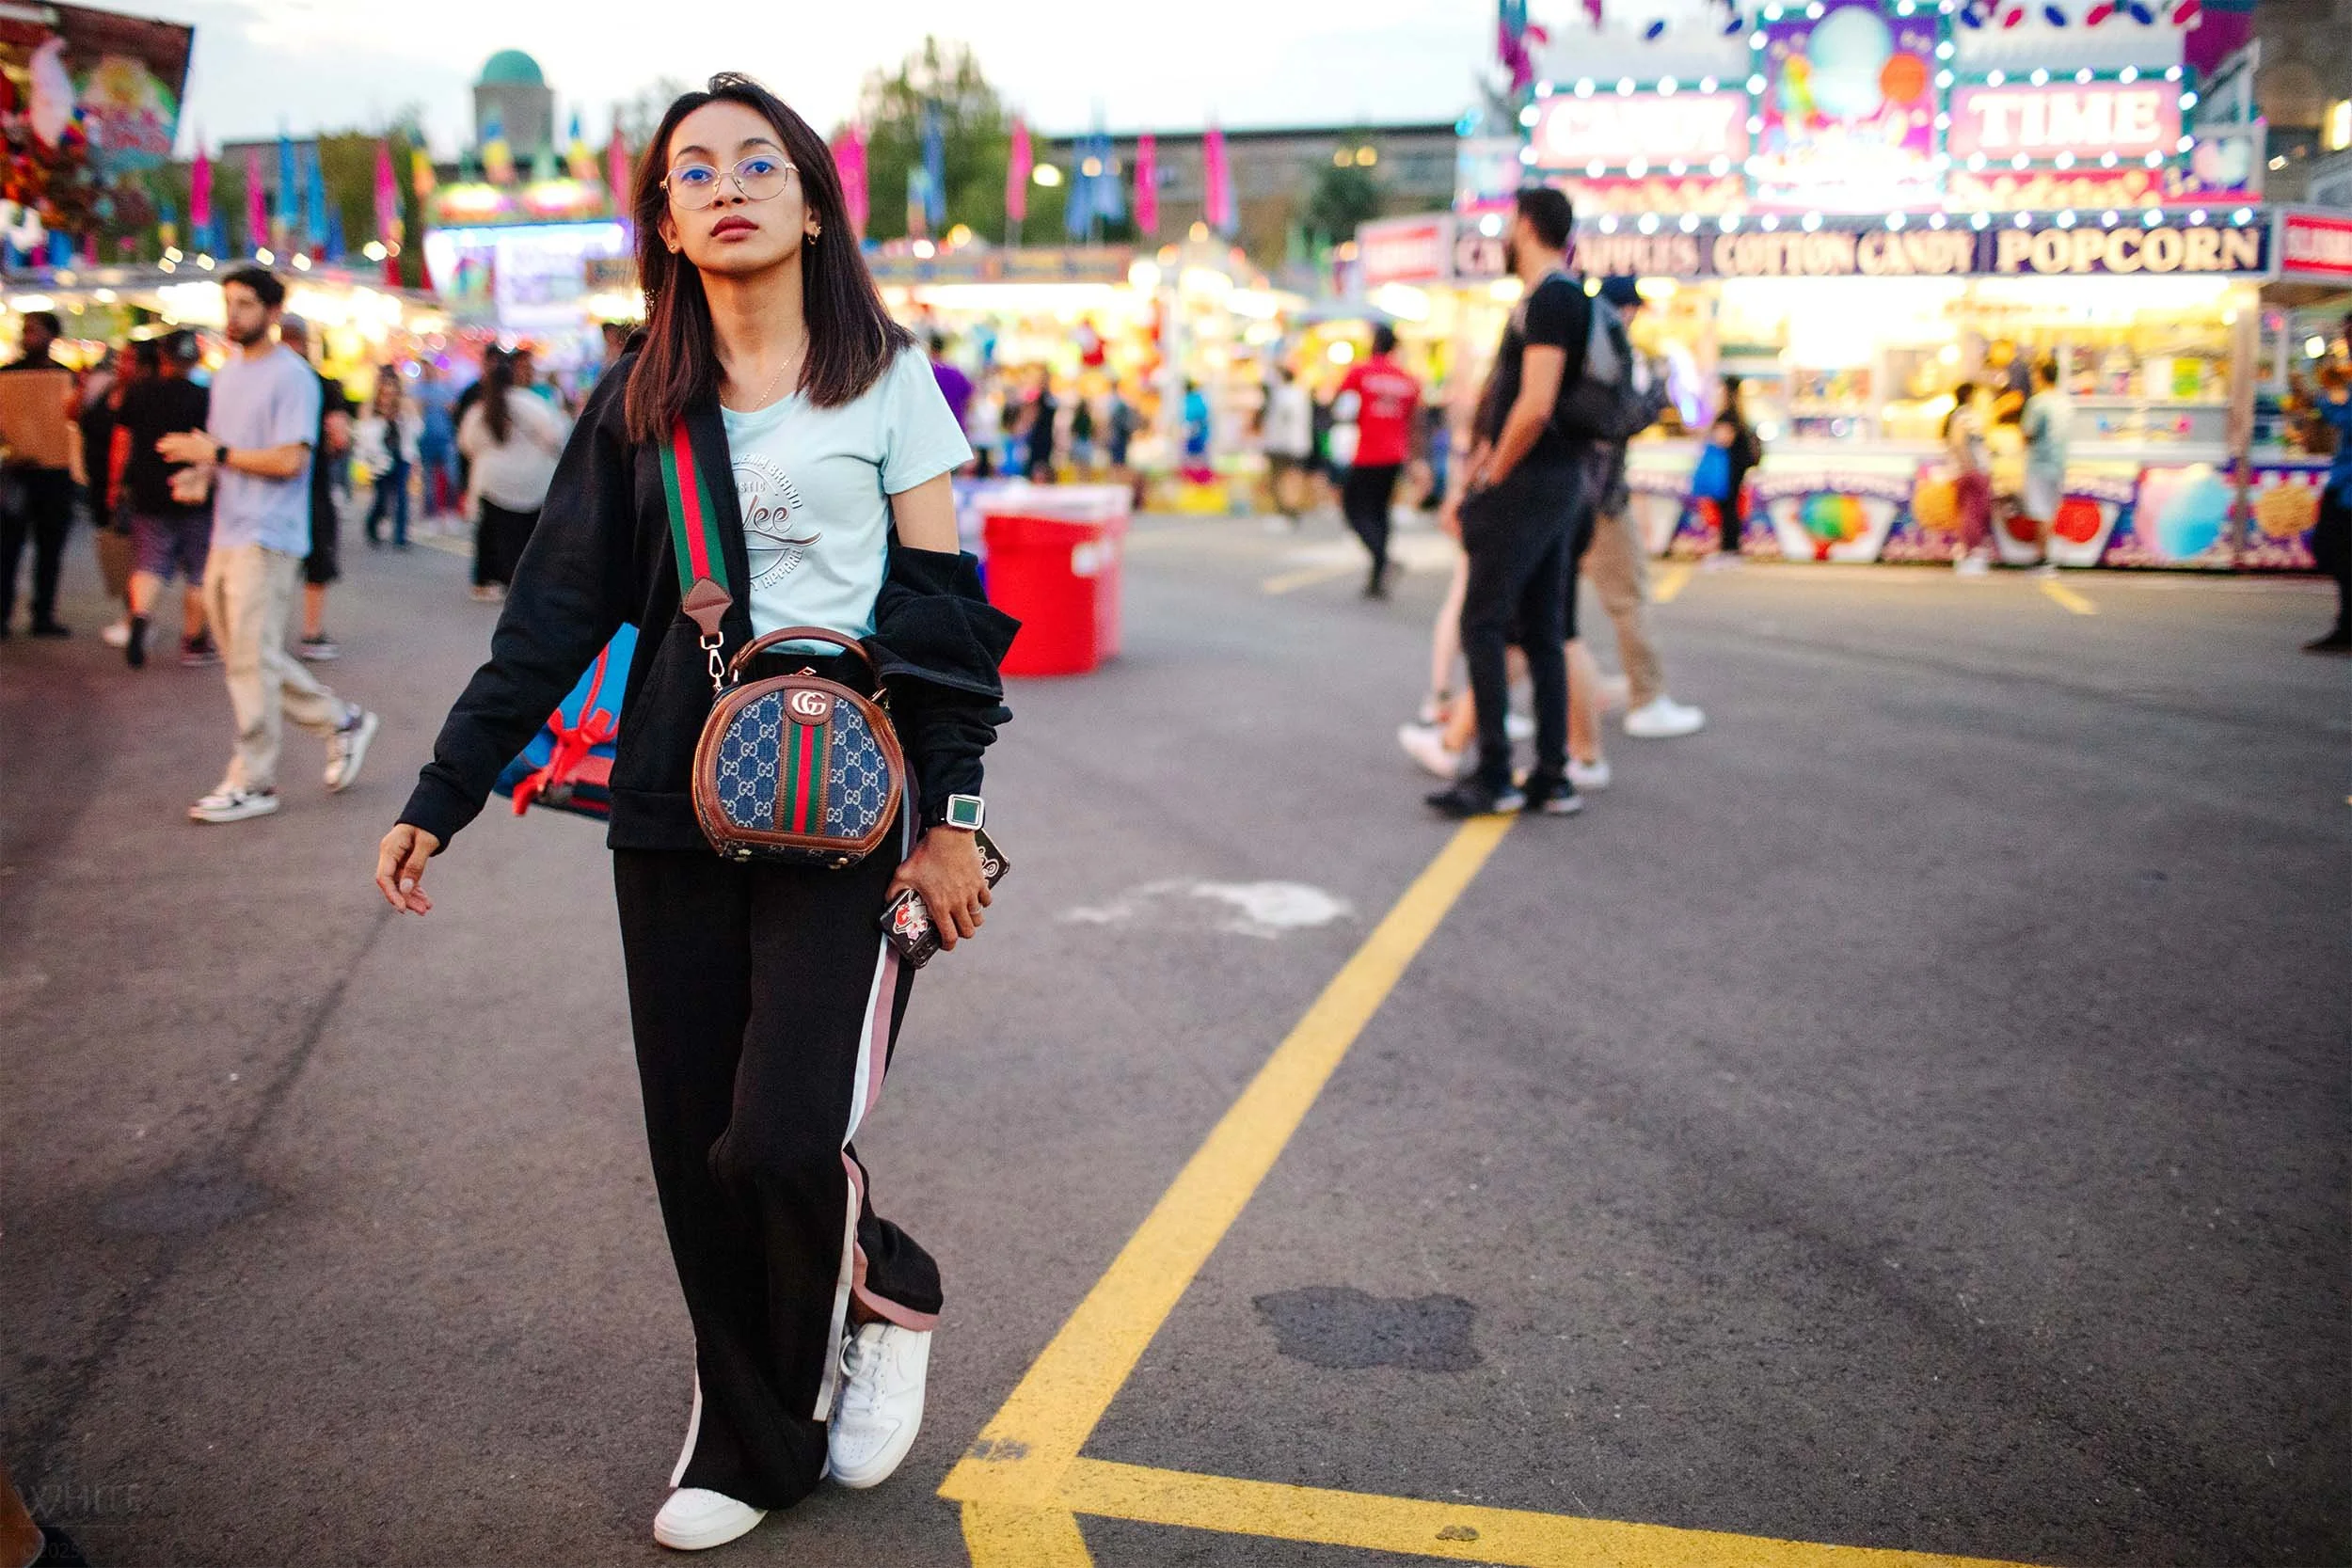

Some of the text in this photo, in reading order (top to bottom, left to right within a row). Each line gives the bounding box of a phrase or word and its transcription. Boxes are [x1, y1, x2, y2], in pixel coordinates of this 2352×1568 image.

[1967, 90, 2162, 148] TIME
[1713, 230, 1975, 275] COTTON CANDY
[1996, 226, 2258, 274] POPCORN
